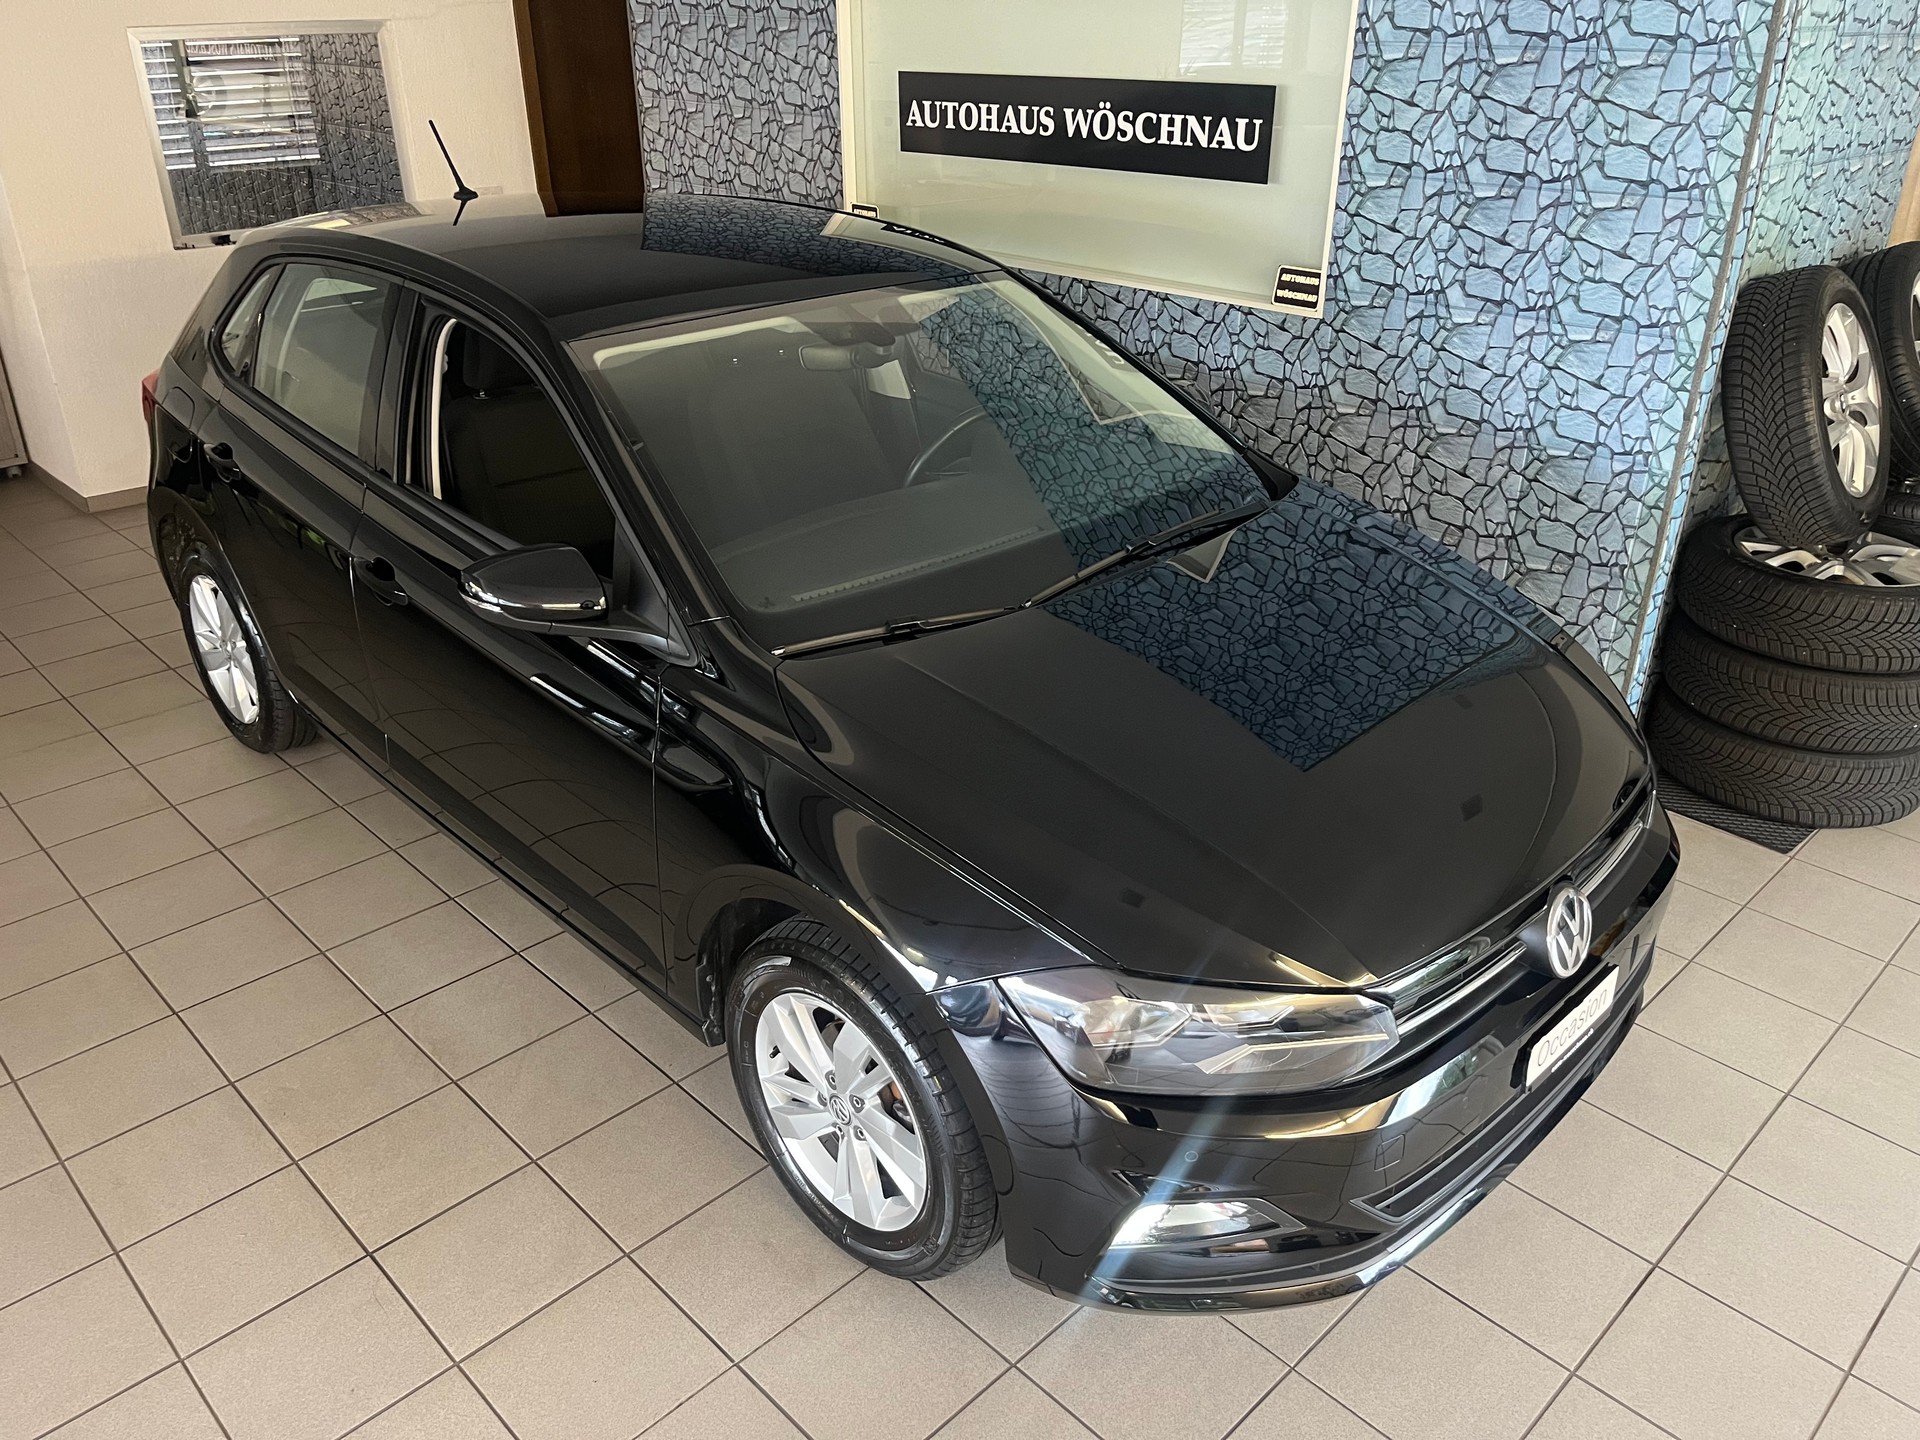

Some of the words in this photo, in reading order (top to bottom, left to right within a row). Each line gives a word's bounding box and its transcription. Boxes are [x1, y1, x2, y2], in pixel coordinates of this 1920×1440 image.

[905, 99, 1055, 138] AUTOHAUS
[1062, 101, 1264, 152] WÖSCHNAU
[1276, 288, 1318, 303] WÖSCHNAU
[1280, 273, 1320, 286] AUTOHAUS
[1537, 988, 1608, 1067] Occasion
